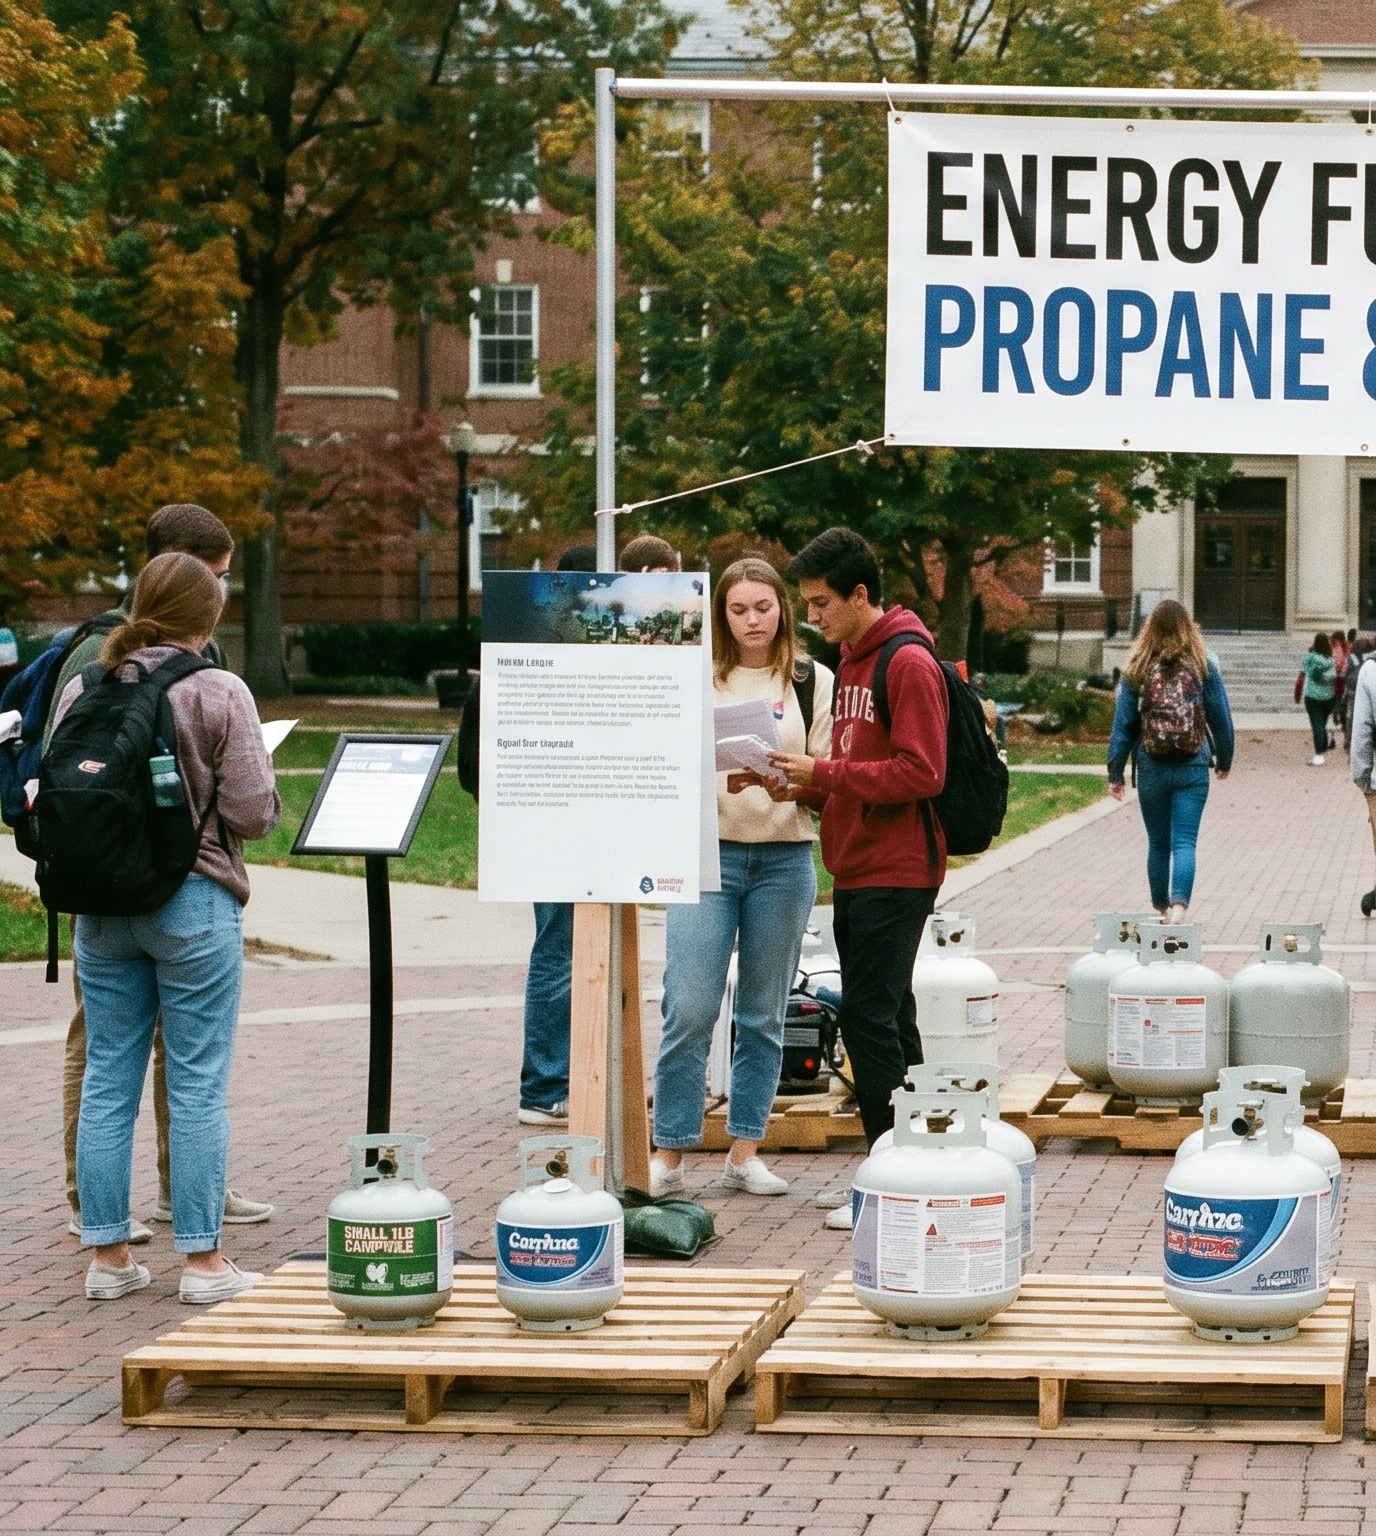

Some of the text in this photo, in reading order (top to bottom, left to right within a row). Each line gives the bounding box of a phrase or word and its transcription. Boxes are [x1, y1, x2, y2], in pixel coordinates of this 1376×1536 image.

[925, 150, 1283, 264] ENERGY
[922, 284, 1331, 401] PROPANE
[344, 1225, 415, 1240] SMALL 1LB
